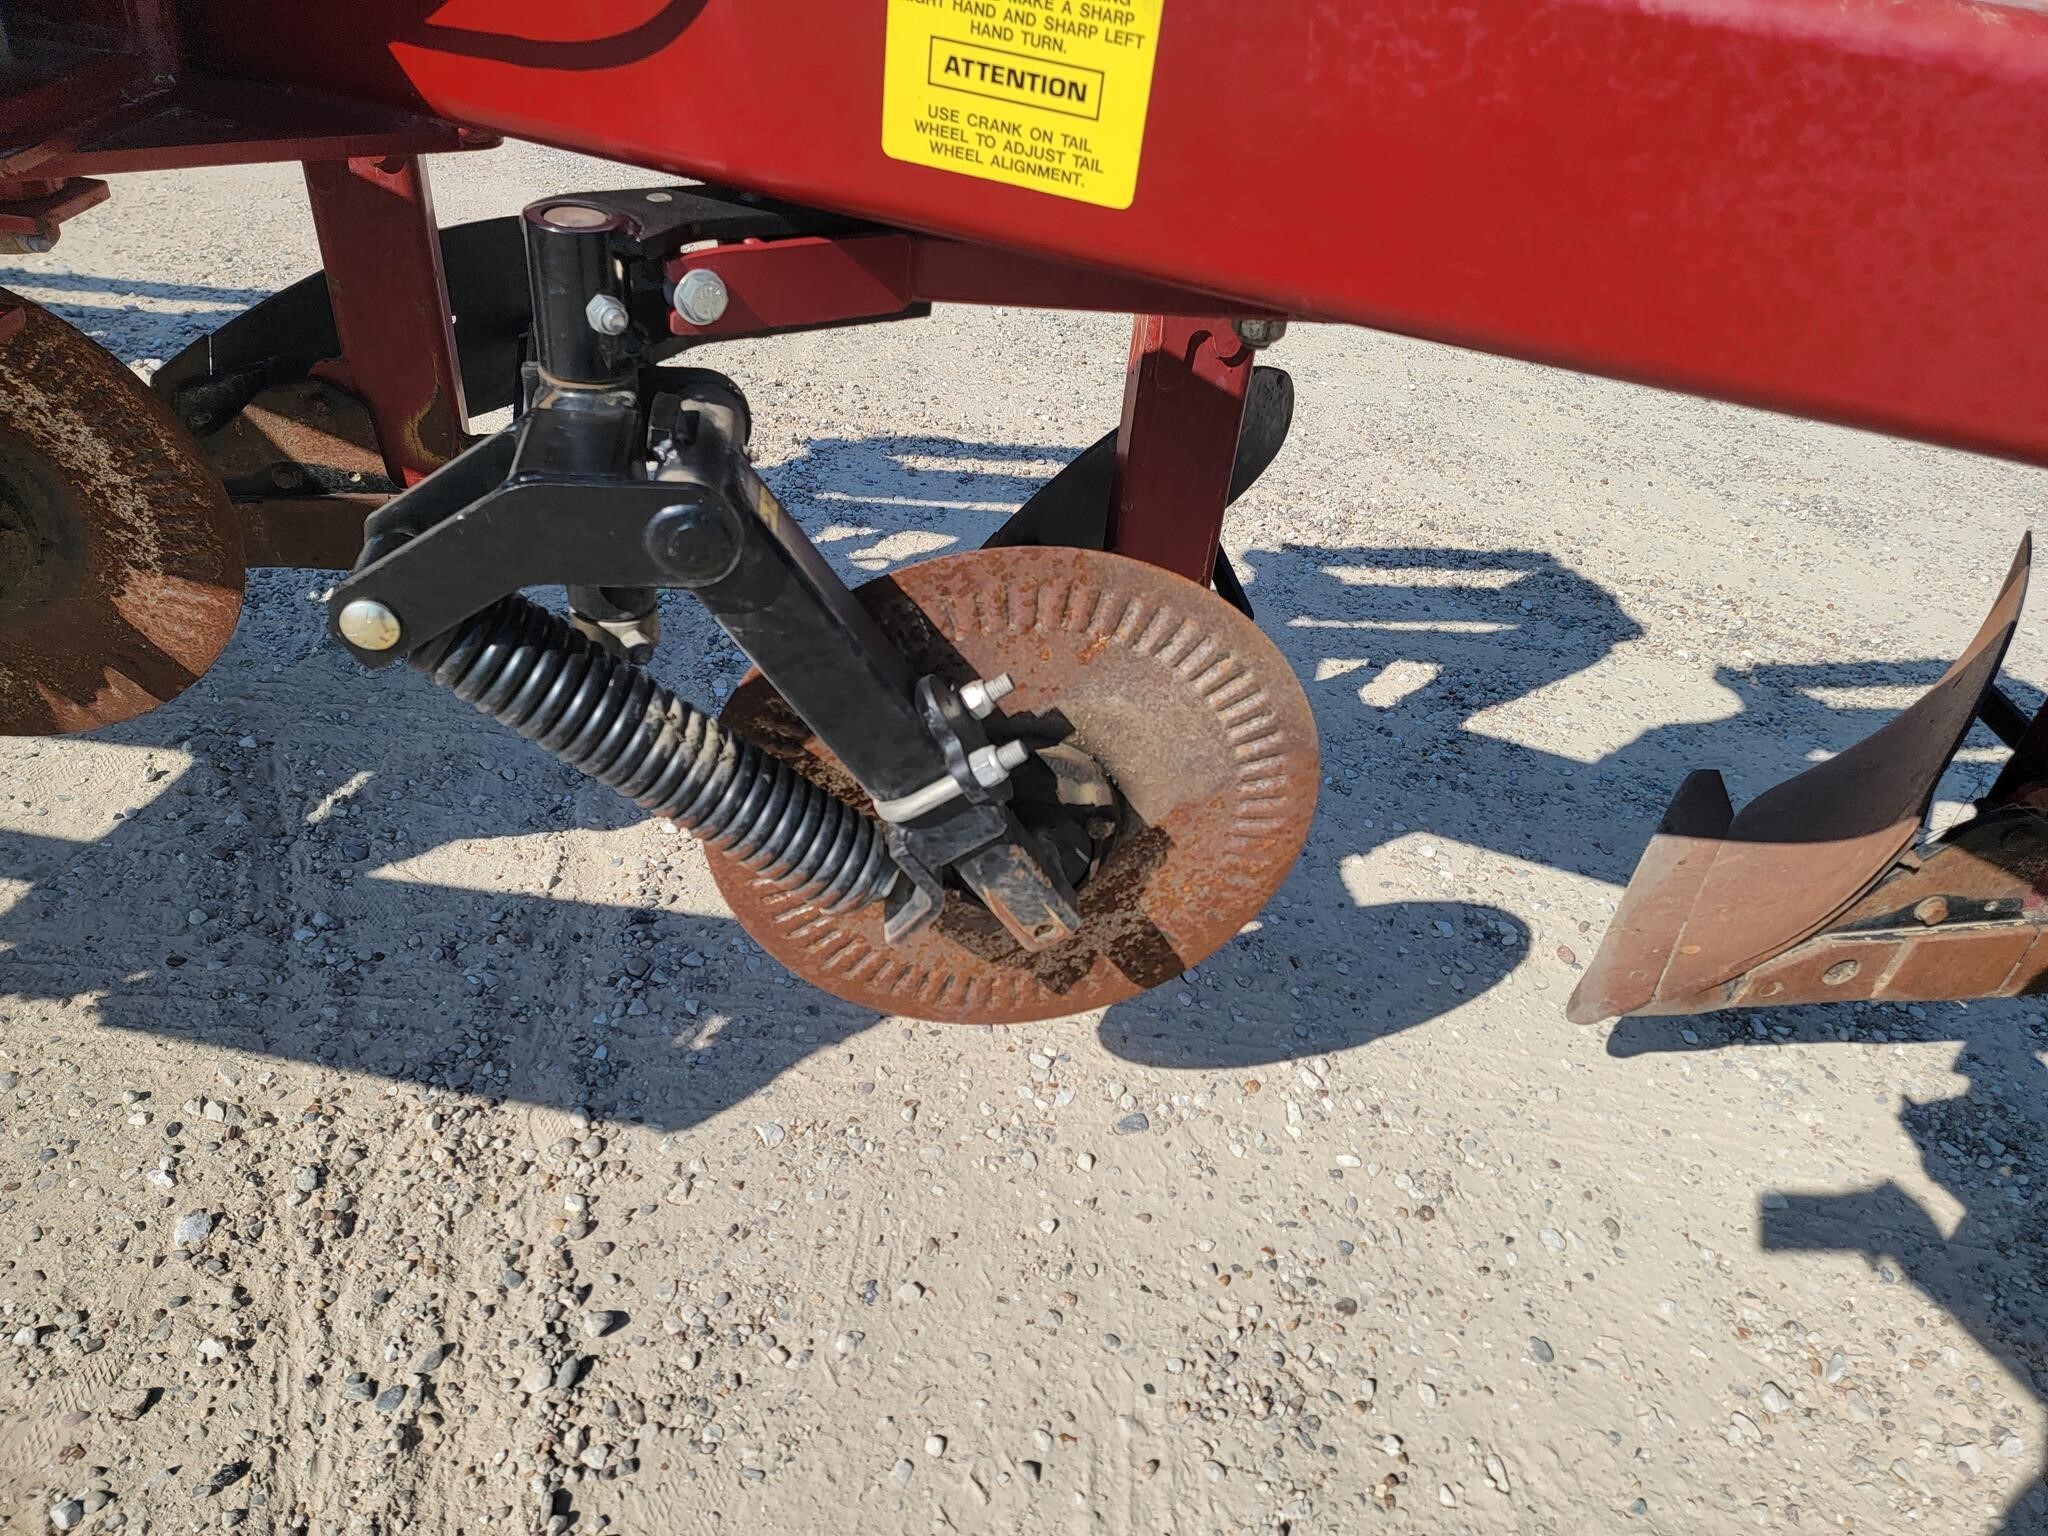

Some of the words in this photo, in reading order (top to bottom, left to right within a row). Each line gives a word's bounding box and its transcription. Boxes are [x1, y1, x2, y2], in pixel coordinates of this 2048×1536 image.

[952, 0, 996, 19] HAND
[1003, 8, 1037, 28] AND
[1043, 15, 1098, 39] SHARP
[1104, 27, 1146, 49] LEFT
[970, 20, 1014, 42] HAND
[1020, 29, 1067, 54] TURN.
[1061, 0, 1072, 16] A
[1079, 2, 1135, 27] SHARP
[943, 55, 1088, 104] ATTENTION
[913, 118, 969, 144] WHEEL
[975, 132, 997, 149] TO
[1002, 139, 1066, 165] ADJUST
[1072, 153, 1104, 174] TAIL
[928, 104, 960, 124] USE
[967, 112, 1022, 138] CRANK
[1029, 127, 1054, 145] ON
[1060, 133, 1093, 153] TAIL
[929, 139, 984, 165] WHEEL
[990, 153, 1086, 188] ALIGNMENT.
